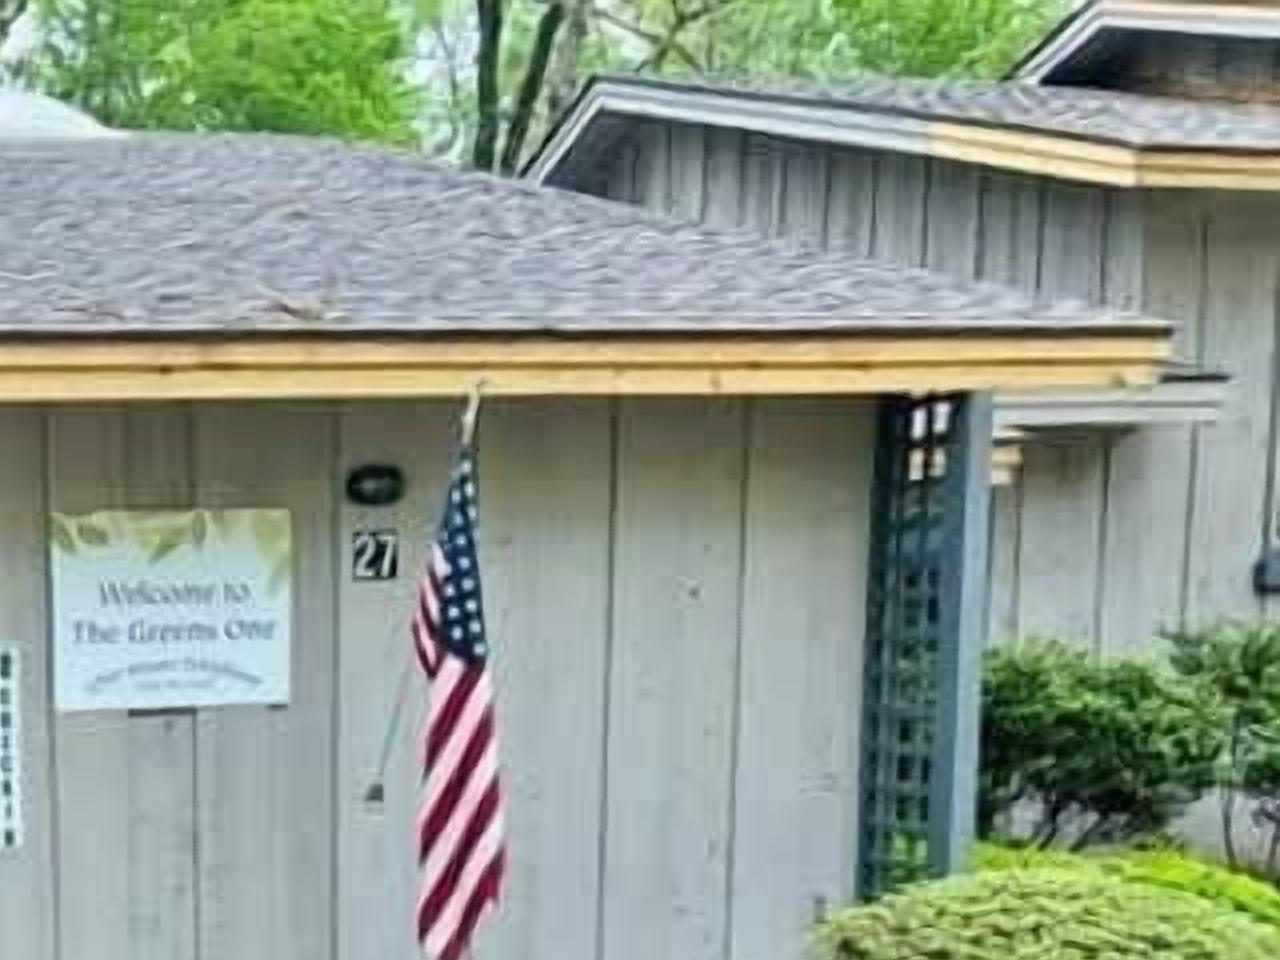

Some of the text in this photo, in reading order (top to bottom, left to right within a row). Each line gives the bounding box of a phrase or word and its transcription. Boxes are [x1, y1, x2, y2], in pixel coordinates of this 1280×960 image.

[354, 534, 396, 578] 27
[98, 580, 253, 605] Welcome to
[73, 618, 121, 644] The
